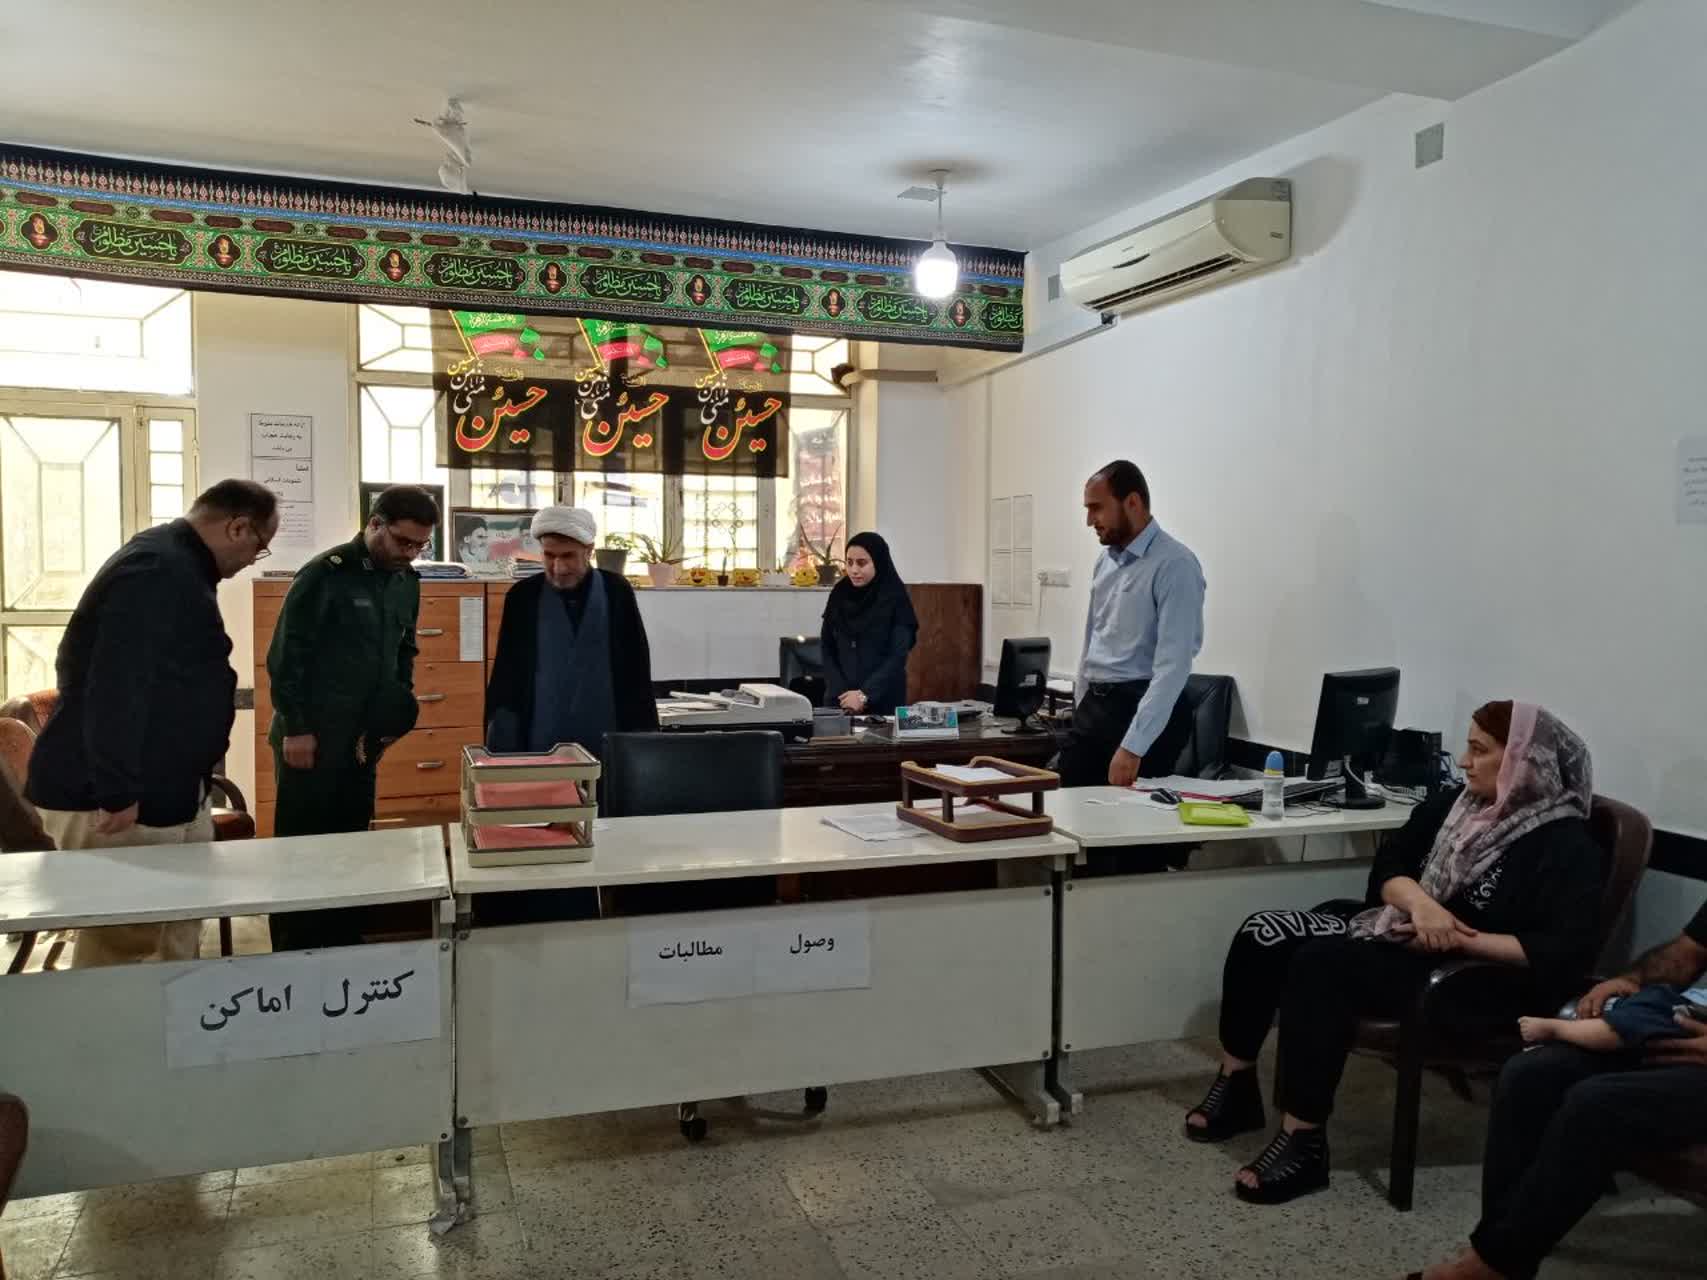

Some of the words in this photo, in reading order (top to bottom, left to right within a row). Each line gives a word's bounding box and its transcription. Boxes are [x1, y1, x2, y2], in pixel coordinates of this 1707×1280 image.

[455, 386, 548, 452] حسین
[583, 391, 669, 456] حسین
[703, 397, 782, 460] حسین
[658, 940, 723, 962] مطالبات
[789, 933, 835, 955] وصول
[200, 984, 292, 1031] اماکن
[322, 969, 415, 1018] کنترل
